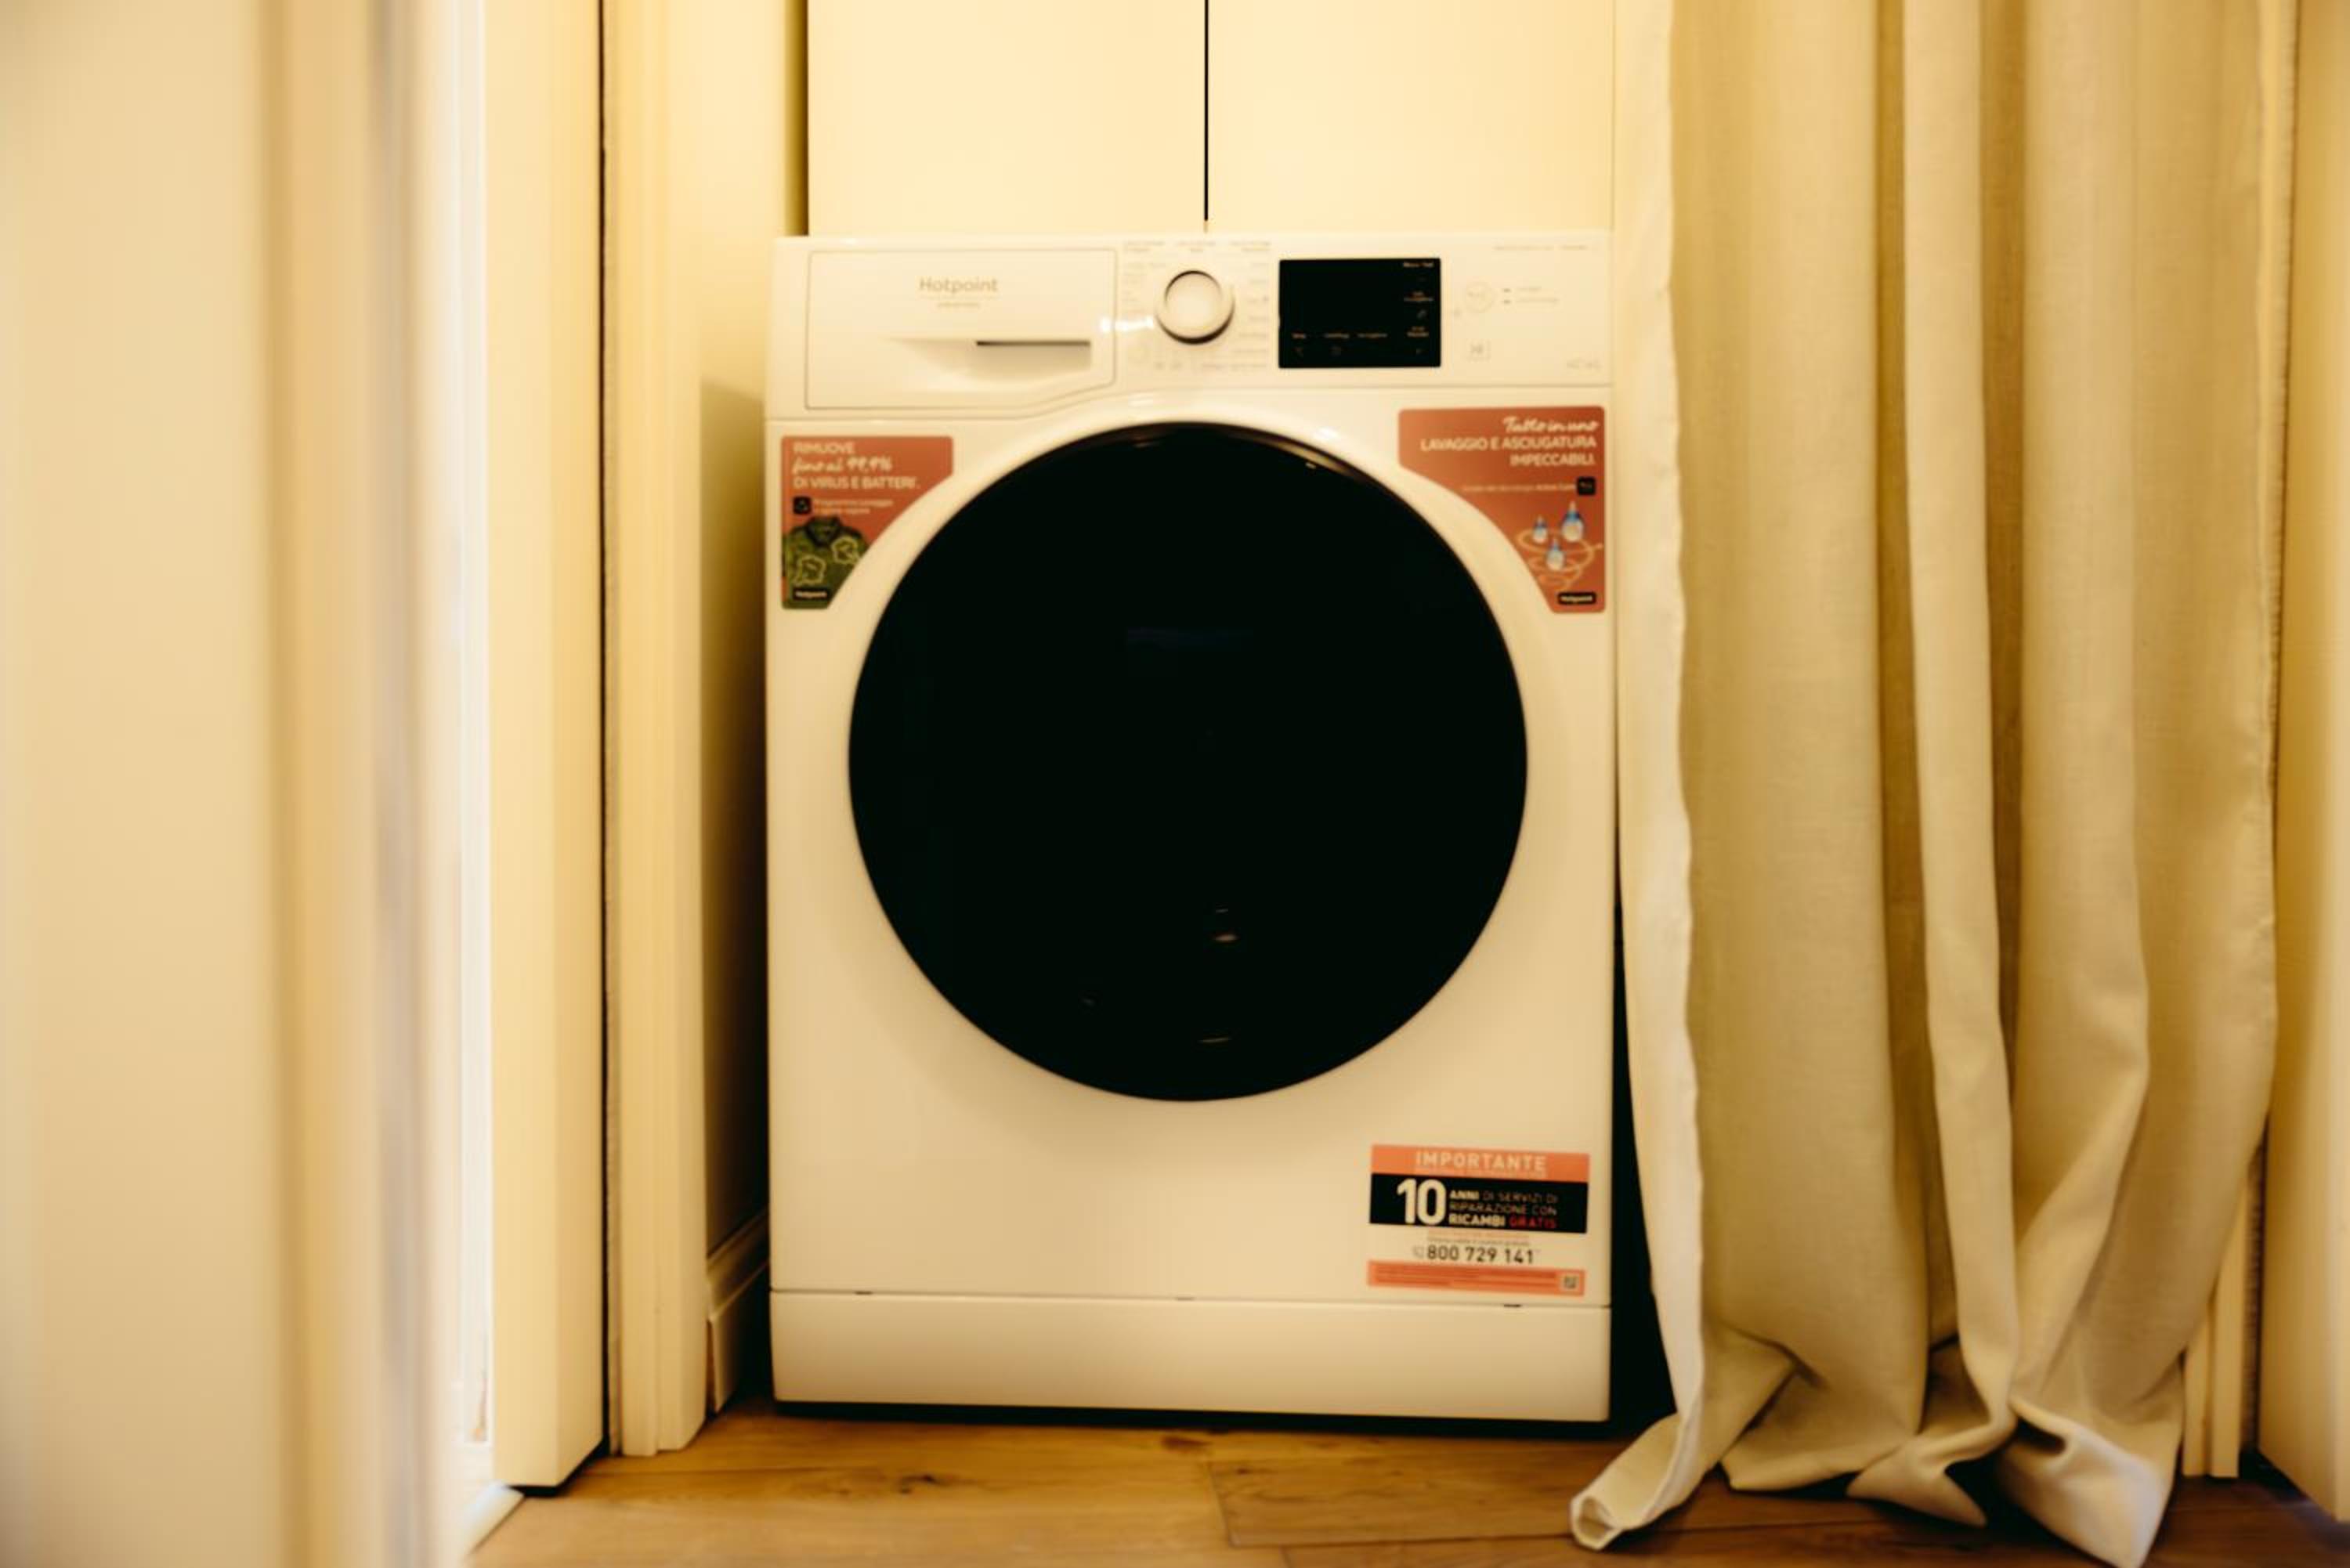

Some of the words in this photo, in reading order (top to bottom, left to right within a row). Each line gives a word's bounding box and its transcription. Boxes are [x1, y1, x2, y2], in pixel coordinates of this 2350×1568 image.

[919, 276, 998, 294] Hotpoint
[793, 442, 855, 454] RIMUOVE
[1420, 437, 1488, 451] LAVAGGIO
[1491, 437, 1499, 450] E
[1502, 435, 1597, 450] ASCIUGATURA
[793, 475, 808, 490] DI
[809, 475, 850, 490] VIRUS
[851, 475, 859, 490] E
[1415, 1151, 1548, 1172] IMPORTANTE
[1397, 1177, 1447, 1226] 10
[1449, 1189, 1480, 1201] ANNI
[1483, 1190, 1495, 1201] DI
[1499, 1191, 1543, 1204] SERVIZI
[1449, 1201, 1528, 1215] RIPARAZIONE
[1531, 1204, 1557, 1216] CON
[1448, 1214, 1506, 1227] RICAMBI
[1509, 1216, 1557, 1229] GRATIS
[1426, 1245, 1459, 1260] 800
[1465, 1246, 1498, 1263] 729
[1505, 1248, 1534, 1264] 141
